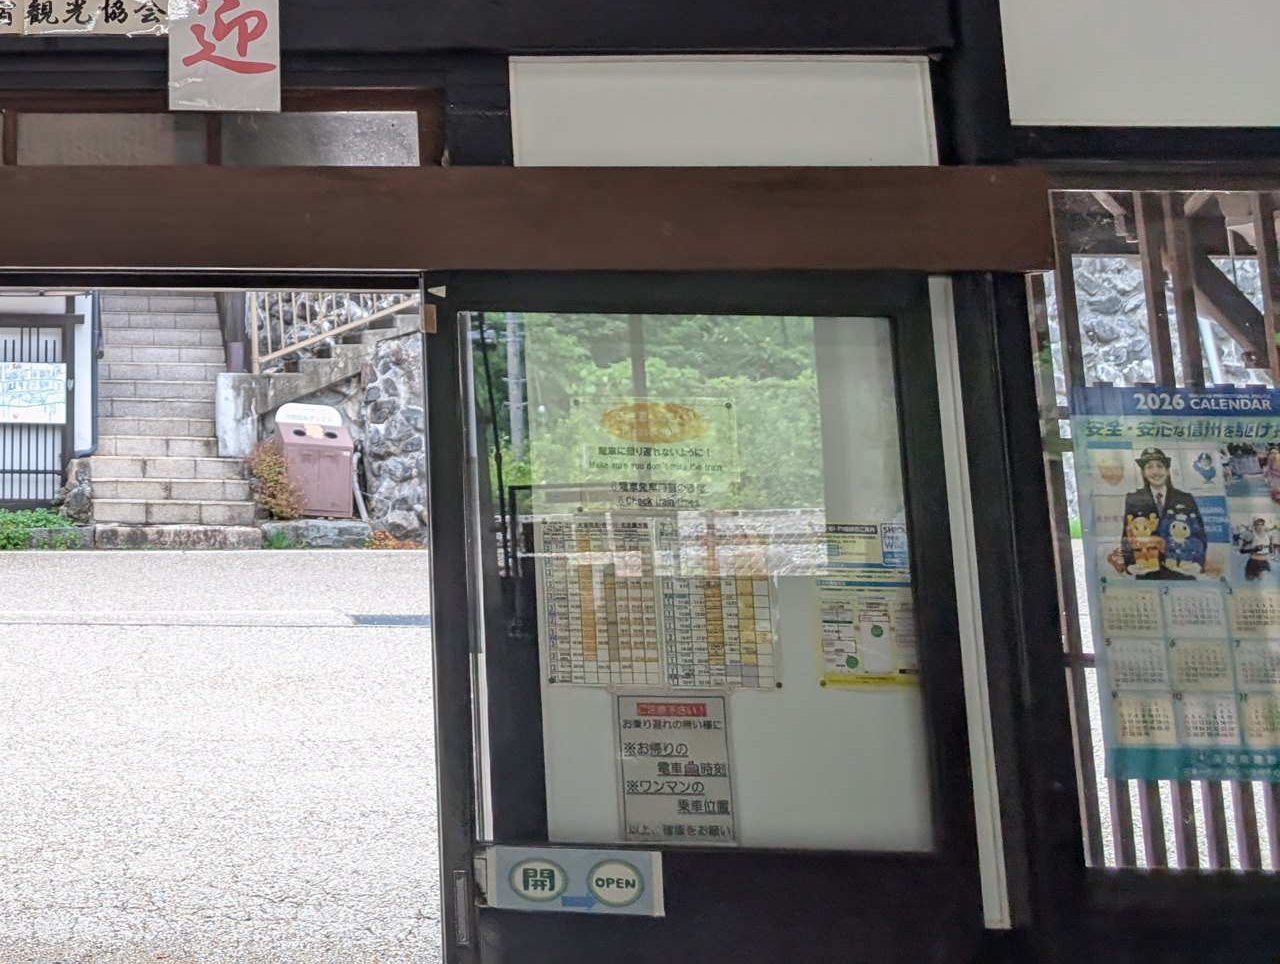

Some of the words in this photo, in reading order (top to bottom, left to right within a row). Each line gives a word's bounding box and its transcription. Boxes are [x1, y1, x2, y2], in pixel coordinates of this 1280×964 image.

[1133, 393, 1185, 410] 2026
[1190, 398, 1271, 410] CALENDAR
[625, 496, 653, 506] Check
[522, 867, 555, 892] 開
[594, 877, 636, 889] OPEN
